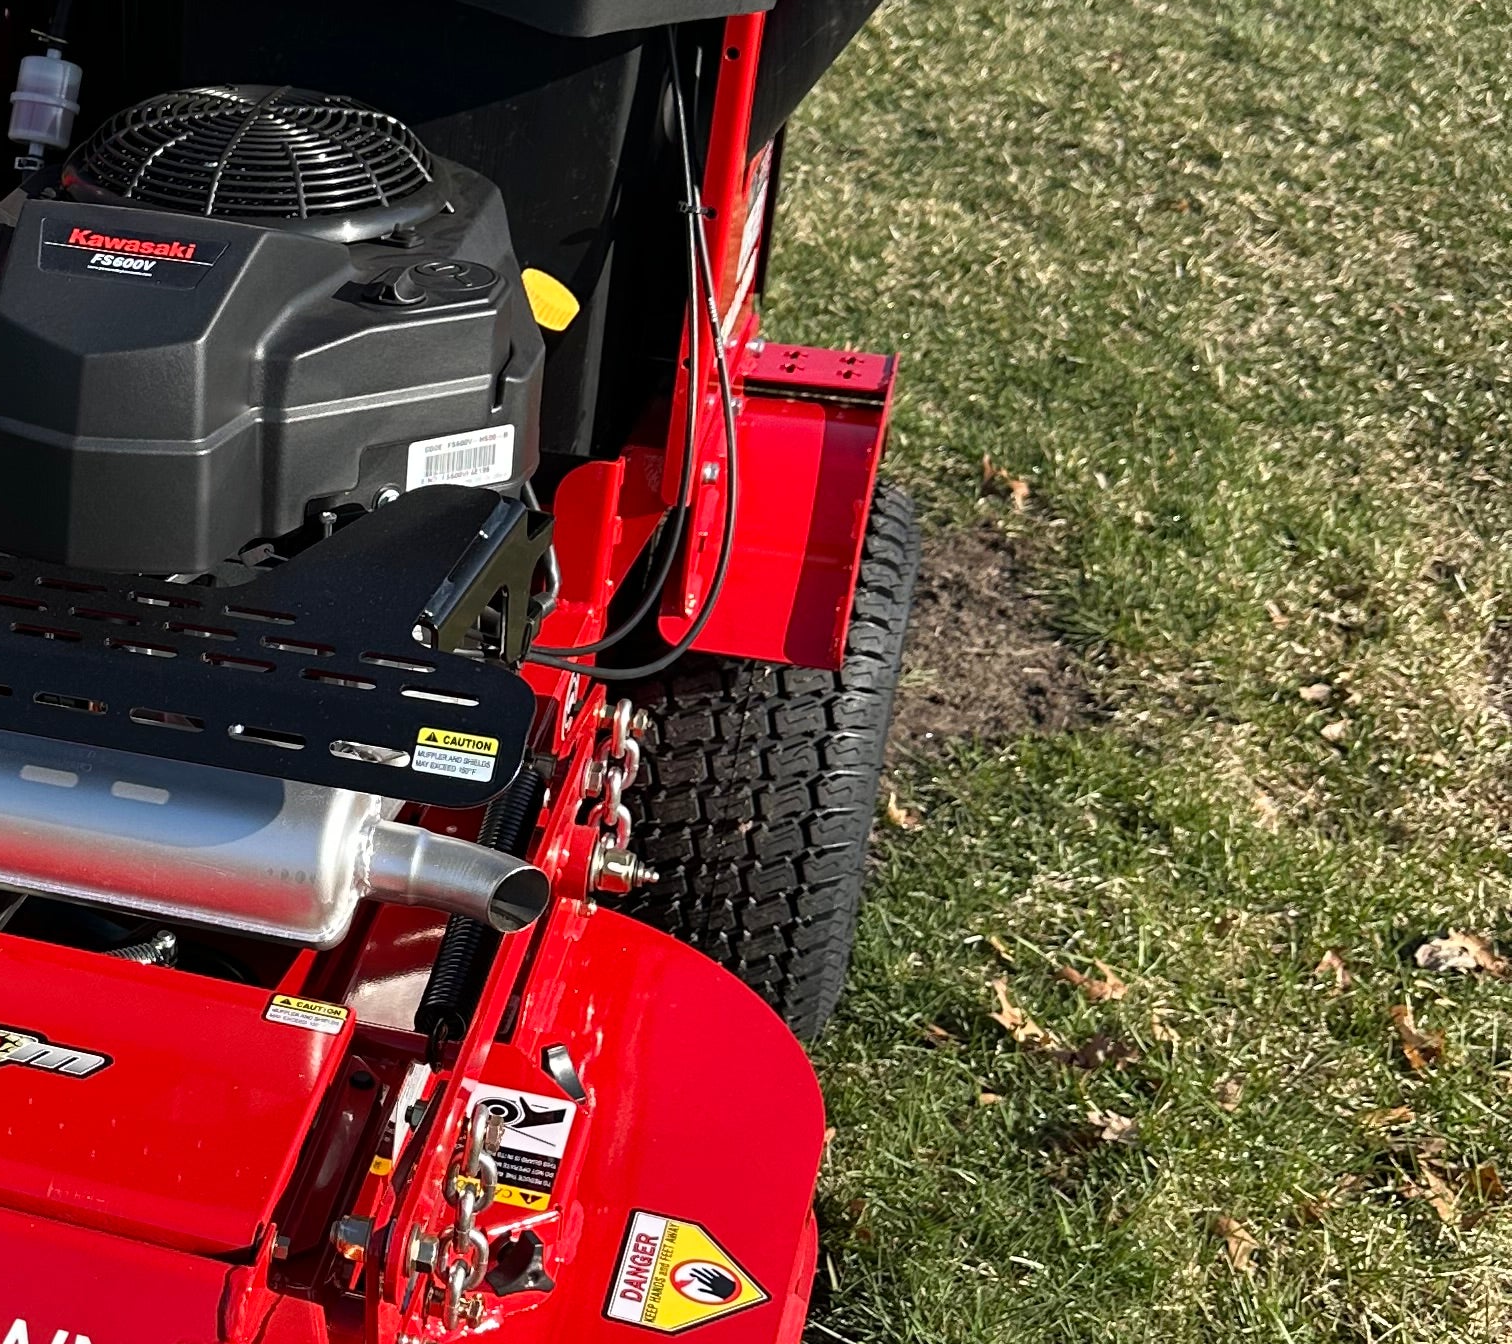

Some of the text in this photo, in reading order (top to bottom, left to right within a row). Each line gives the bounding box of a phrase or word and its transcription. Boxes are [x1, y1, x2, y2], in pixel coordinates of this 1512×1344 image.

[68, 228, 197, 259] Kawasaki
[90, 254, 157, 271] FS600V
[443, 735, 492, 751] CAUTION
[296, 1001, 342, 1016] CAUTION
[619, 1232, 659, 1303] DANGER
[644, 1223, 680, 1323] KEEP HANDS and FEET AWAY
